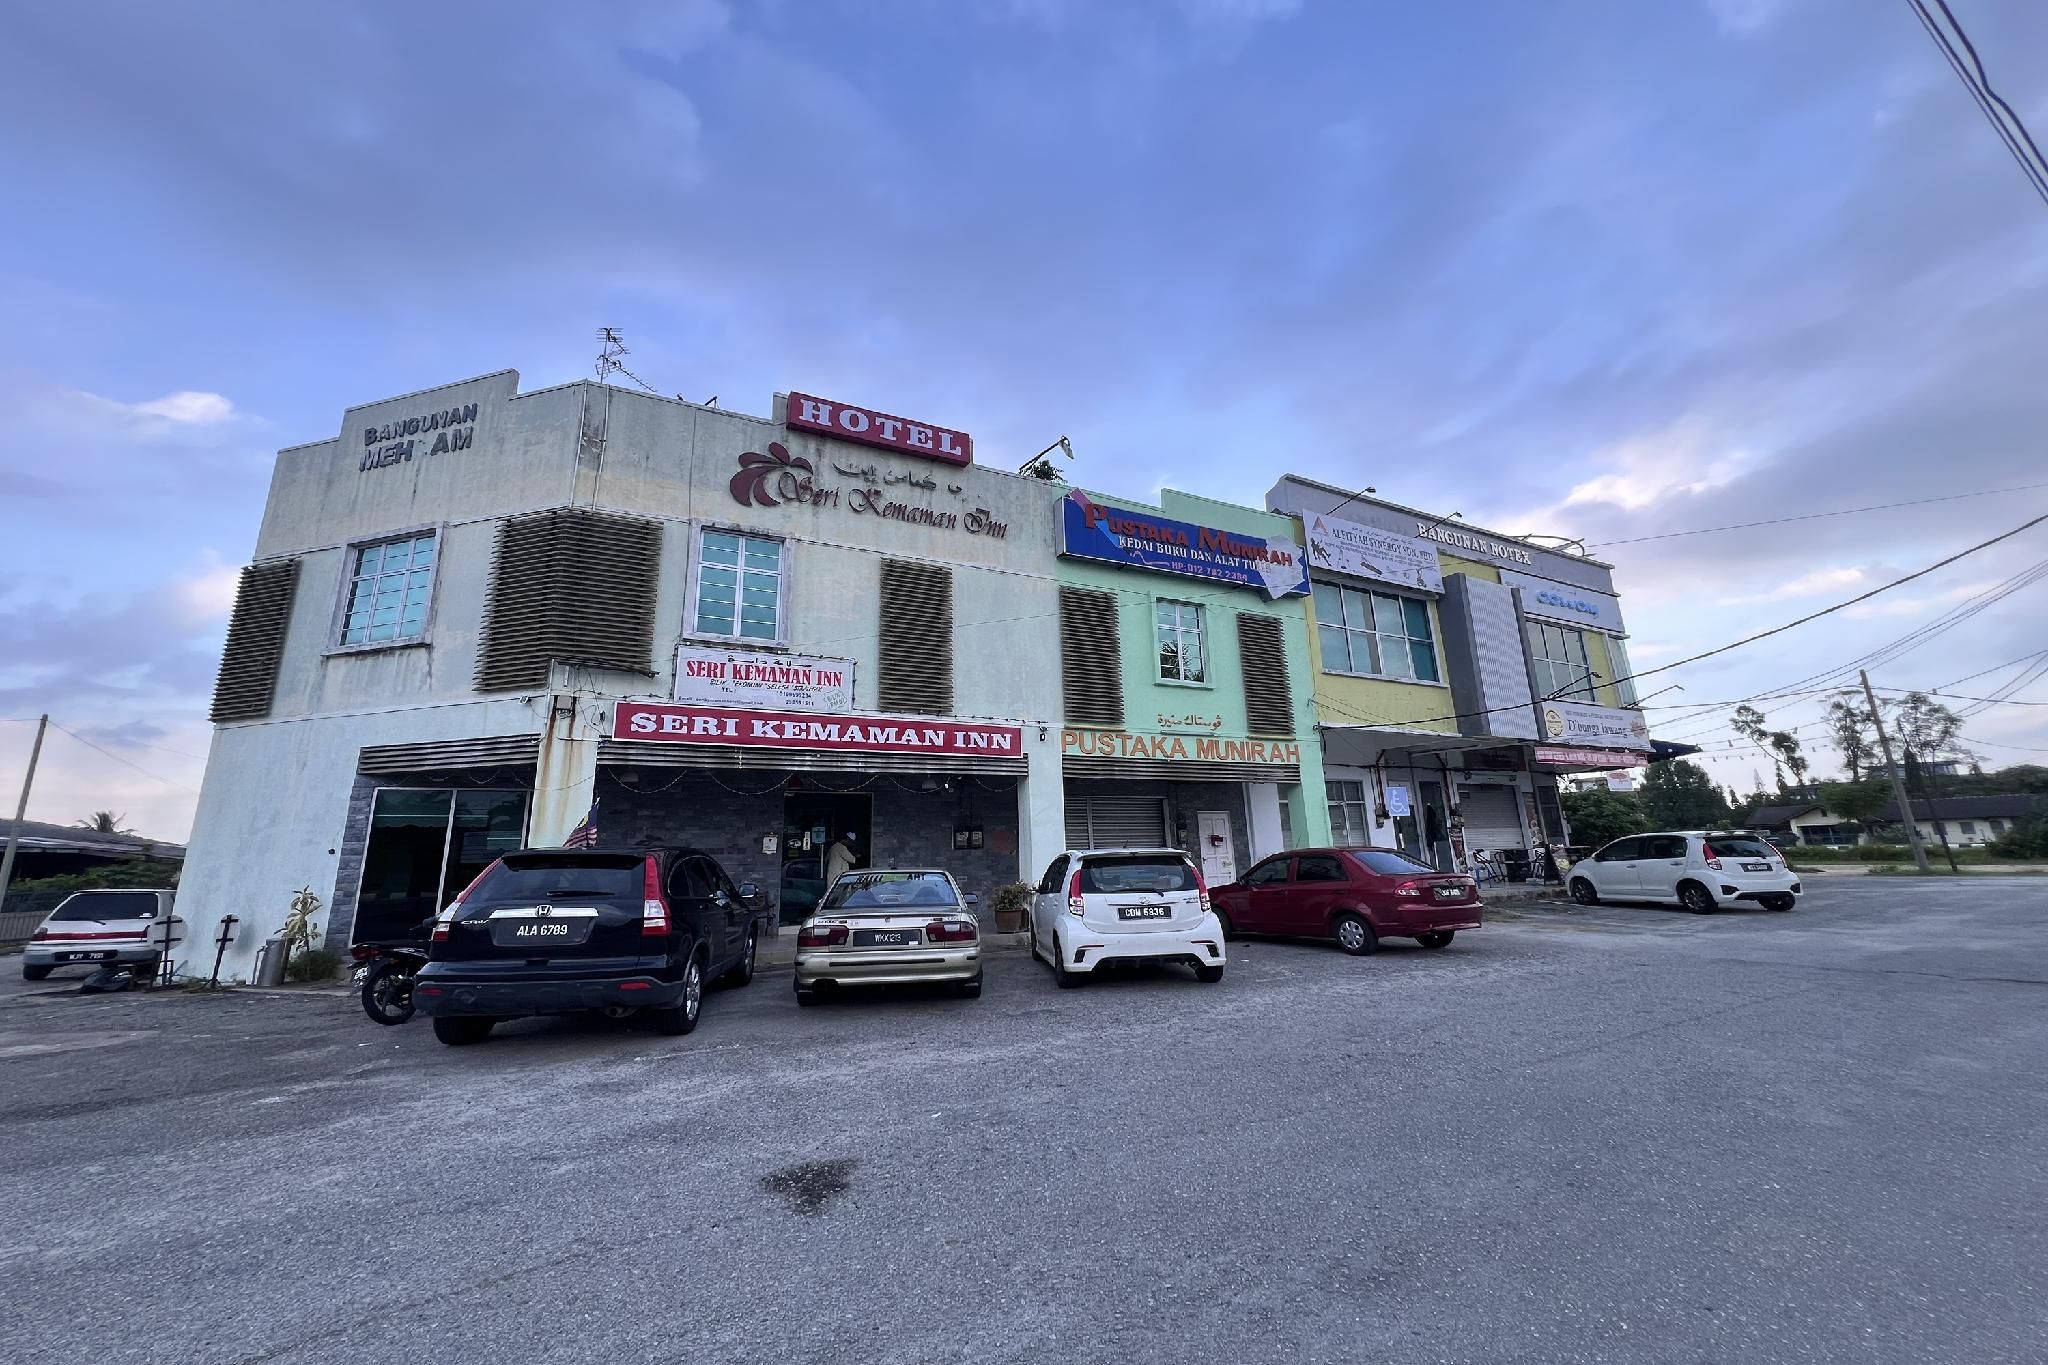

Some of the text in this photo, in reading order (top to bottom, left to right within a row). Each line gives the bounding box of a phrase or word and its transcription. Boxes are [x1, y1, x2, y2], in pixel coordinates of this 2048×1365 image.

[364, 402, 478, 447] BANGUNAN
[799, 398, 962, 456] HOTEL
[779, 471, 840, 509] Seri
[848, 488, 957, 529] Kemaman
[1085, 503, 1188, 545] PUSTAKA
[1199, 527, 1293, 566] MUNIRAH
[1119, 536, 1153, 552] KEDAI
[1157, 543, 1187, 558] BUKU
[1191, 549, 1212, 562] DAN
[1215, 554, 1240, 568] ALAT
[1416, 522, 1488, 554] BANGUNAN
[1489, 543, 1532, 566] NOTEX
[687, 660, 727, 679] SERI
[732, 665, 811, 686] KEMAMAN
[816, 671, 843, 687] INN
[630, 711, 1013, 750] SERI KEMAMAN INN
[1060, 730, 1301, 763] PUSTAKA MUNIRAH
[517, 925, 567, 936] ALA 6789
